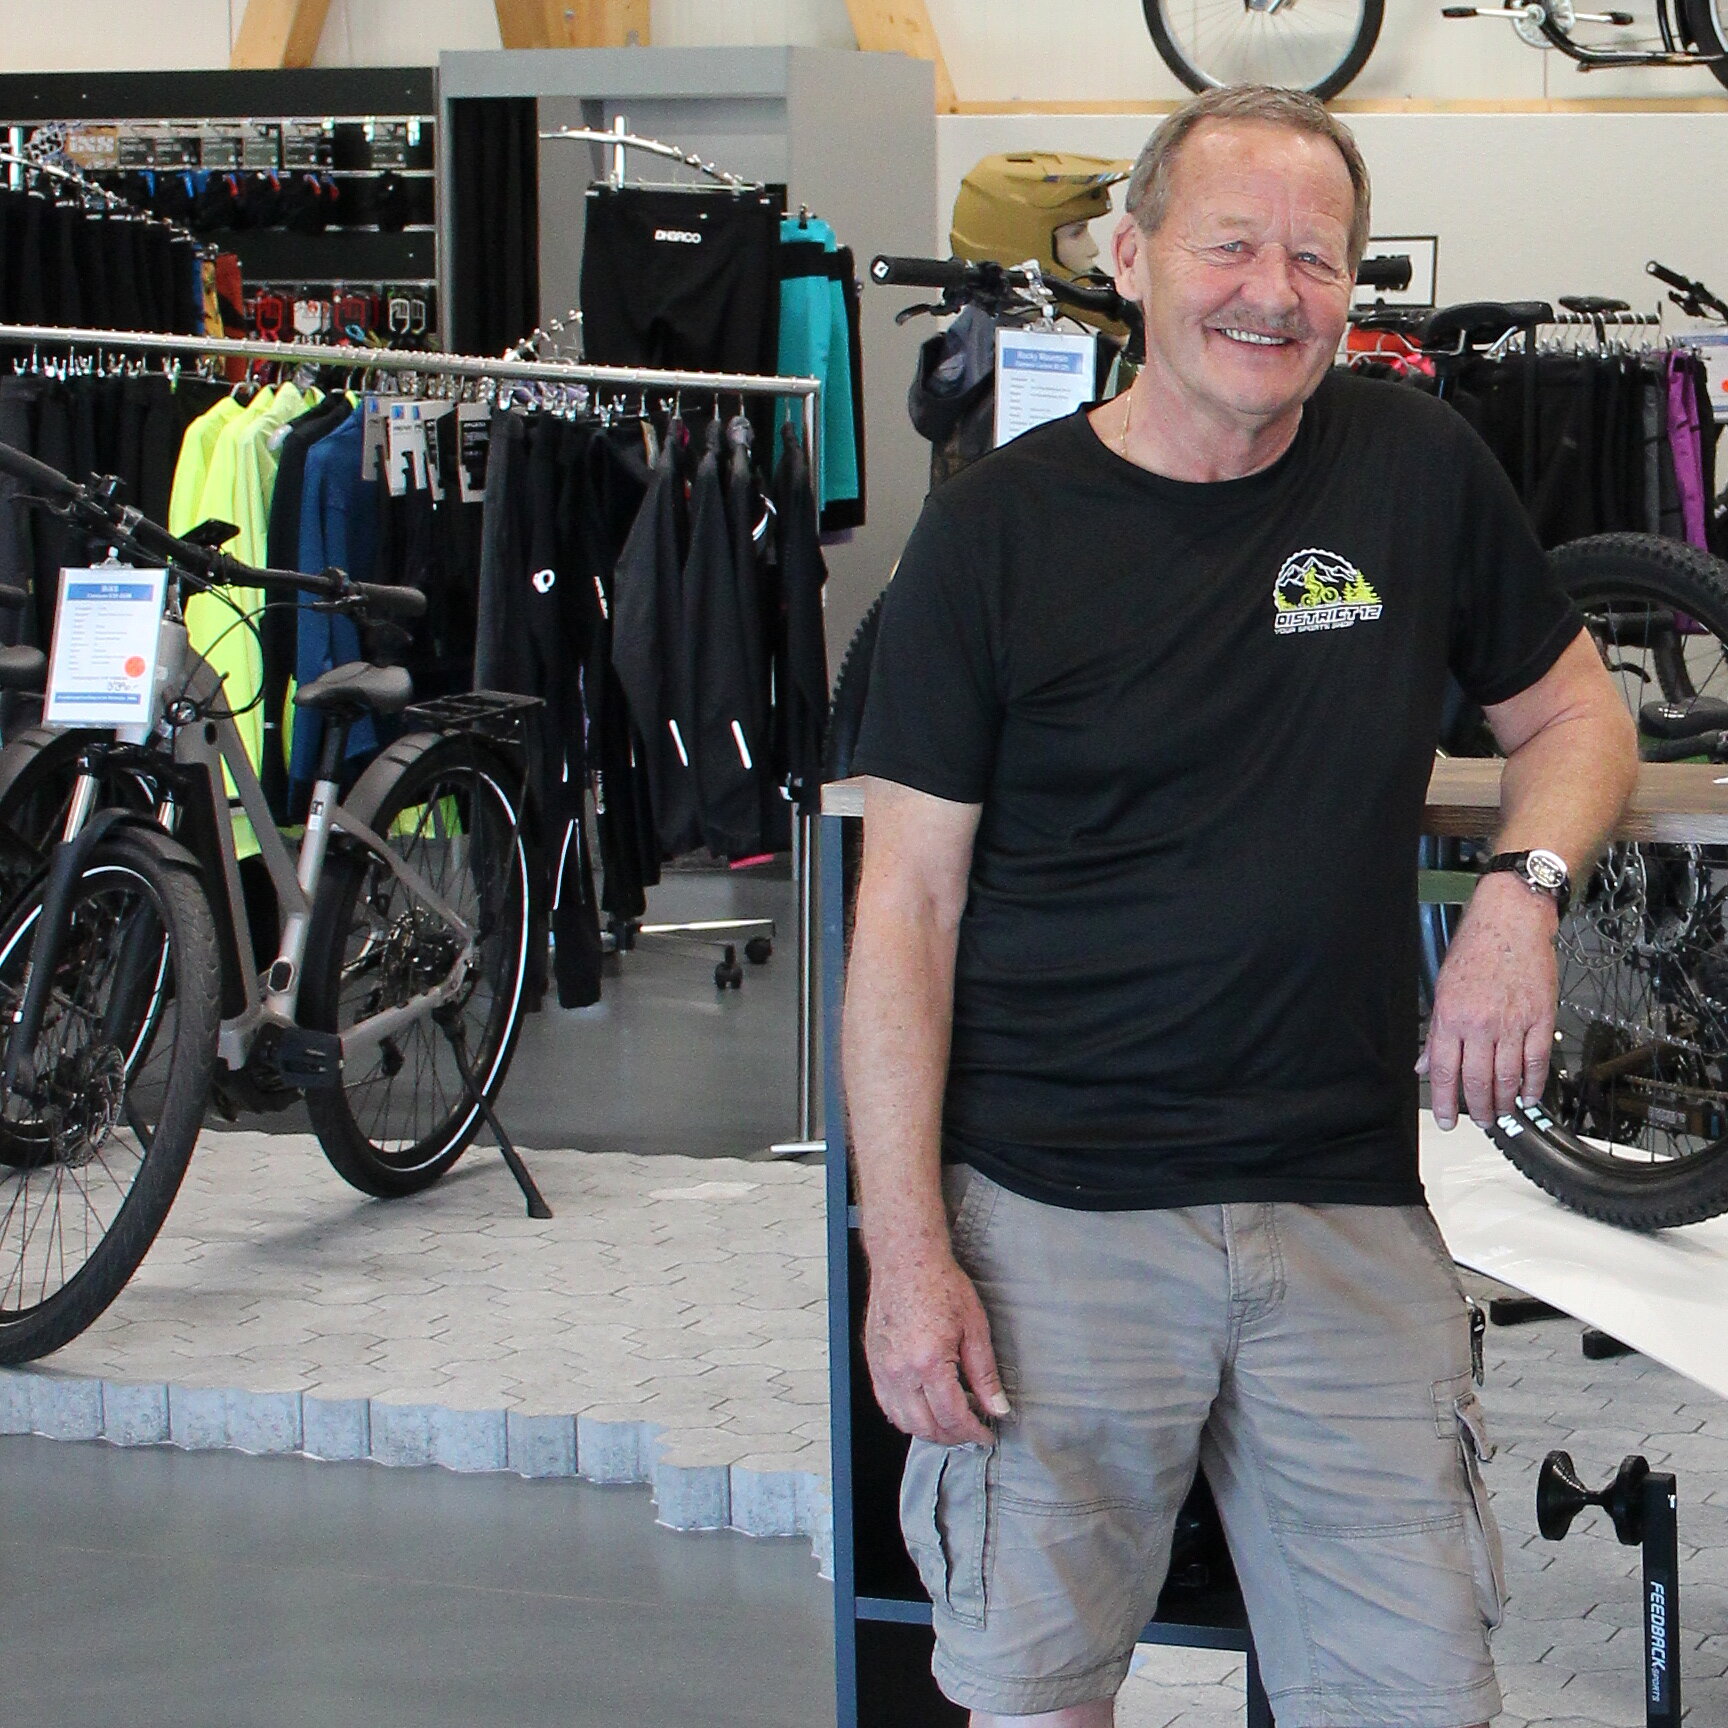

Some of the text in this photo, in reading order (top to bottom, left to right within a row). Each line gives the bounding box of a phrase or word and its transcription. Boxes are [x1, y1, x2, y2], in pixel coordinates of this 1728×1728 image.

[1275, 605, 1383, 628] DISTRICT 12
[1651, 1580, 1666, 1703] FEEDBACK SPORTS
